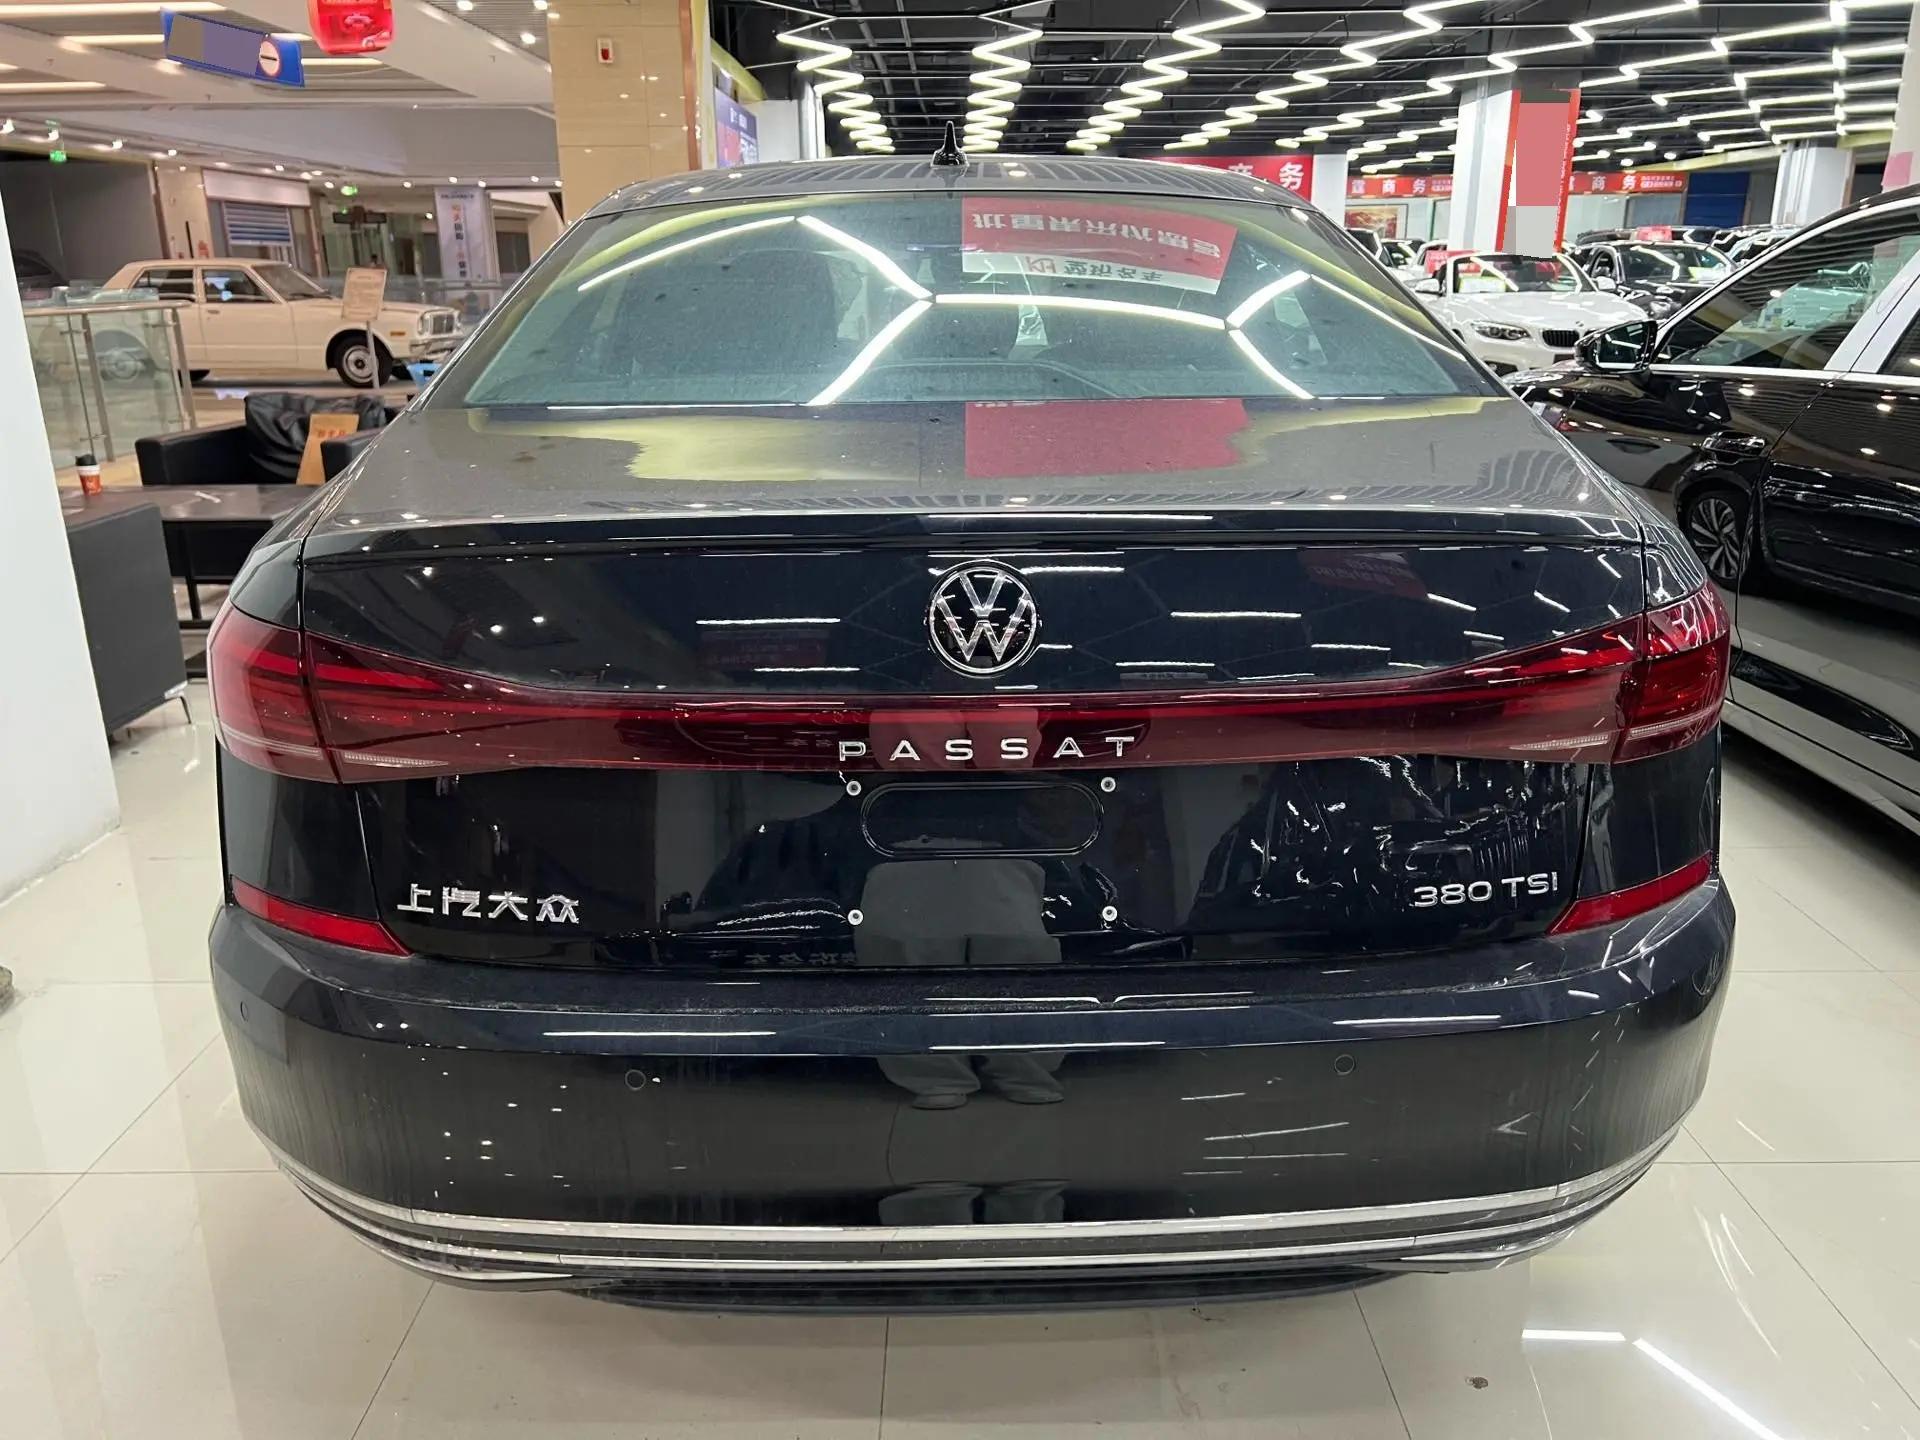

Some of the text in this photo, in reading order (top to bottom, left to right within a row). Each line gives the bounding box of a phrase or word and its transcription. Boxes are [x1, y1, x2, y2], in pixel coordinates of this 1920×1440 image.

[838, 736, 1135, 762] PASSAT
[397, 883, 579, 924] 上汽大众
[1413, 871, 1558, 908] 380 TSI
